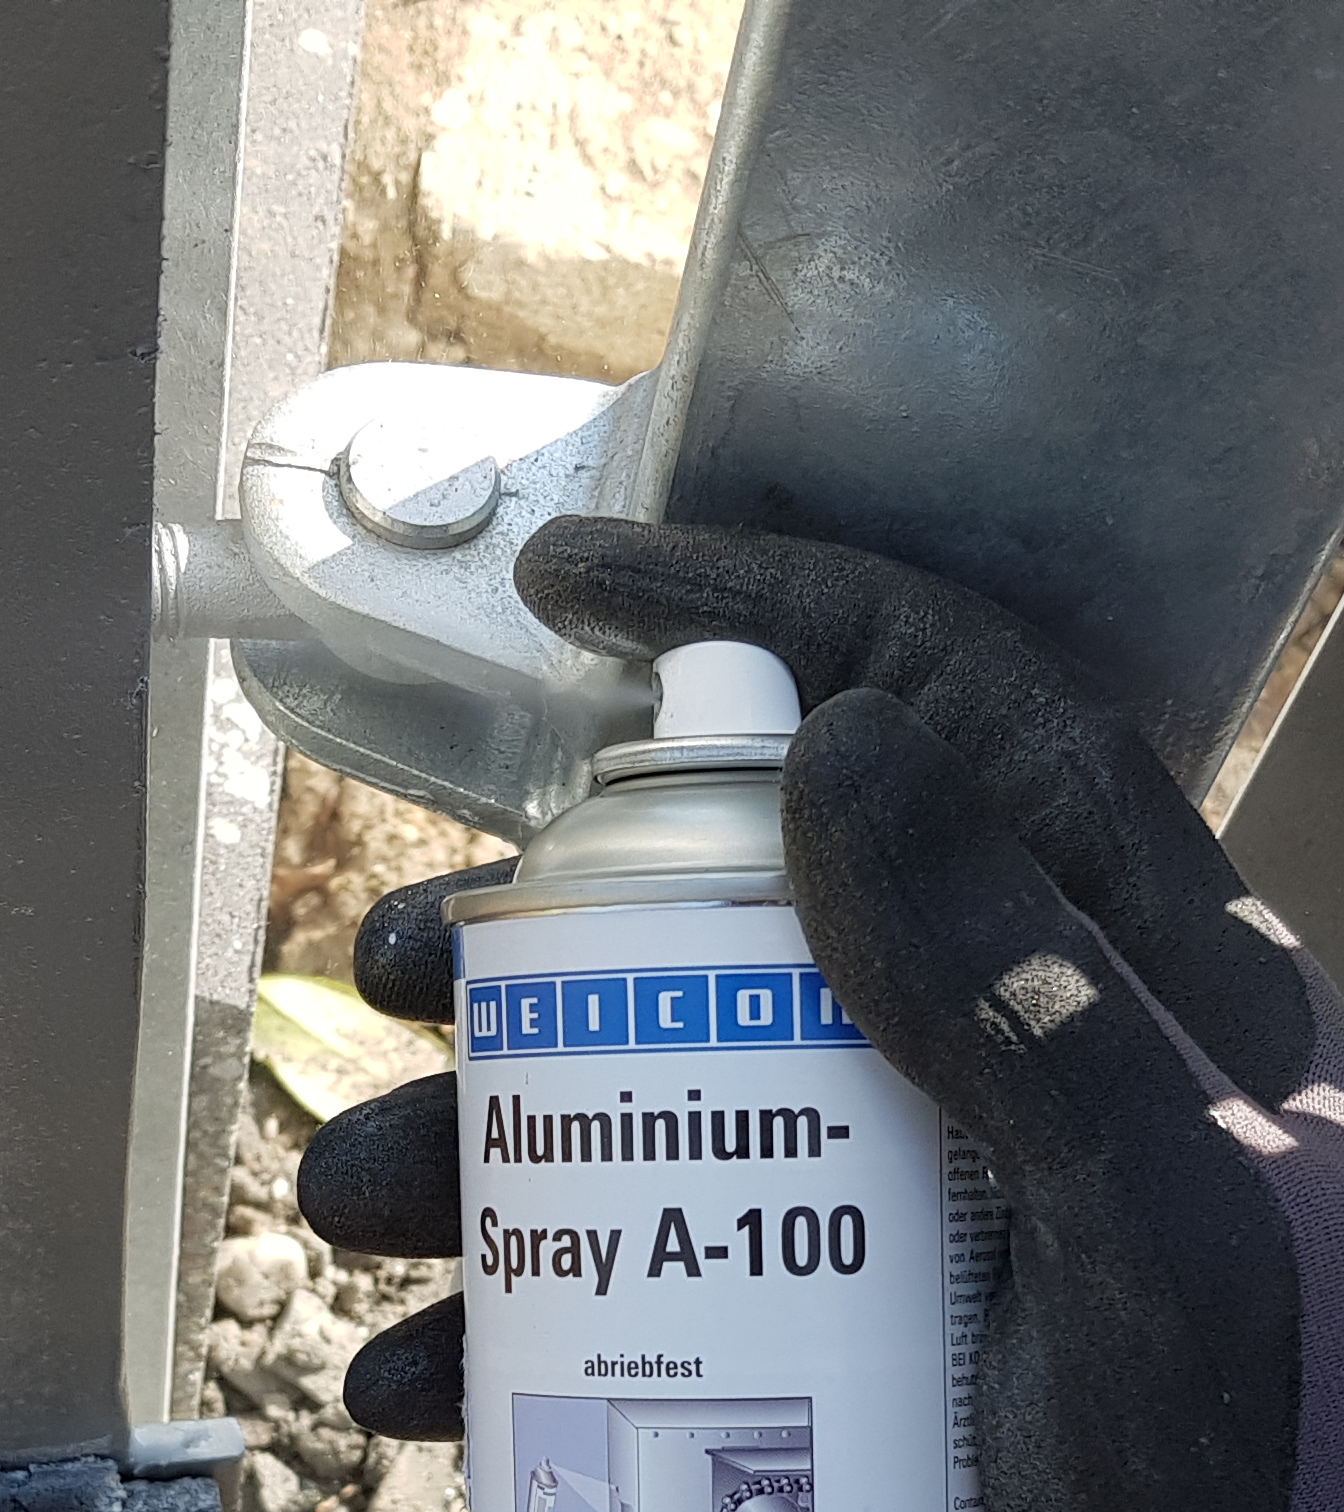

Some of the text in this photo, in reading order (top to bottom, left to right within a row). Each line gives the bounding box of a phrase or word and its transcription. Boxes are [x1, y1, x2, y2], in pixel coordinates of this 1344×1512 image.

[484, 1089, 849, 1164] Aluminium-
[480, 1205, 866, 1295] Spray A-100
[584, 1354, 703, 1379] abriebfest
